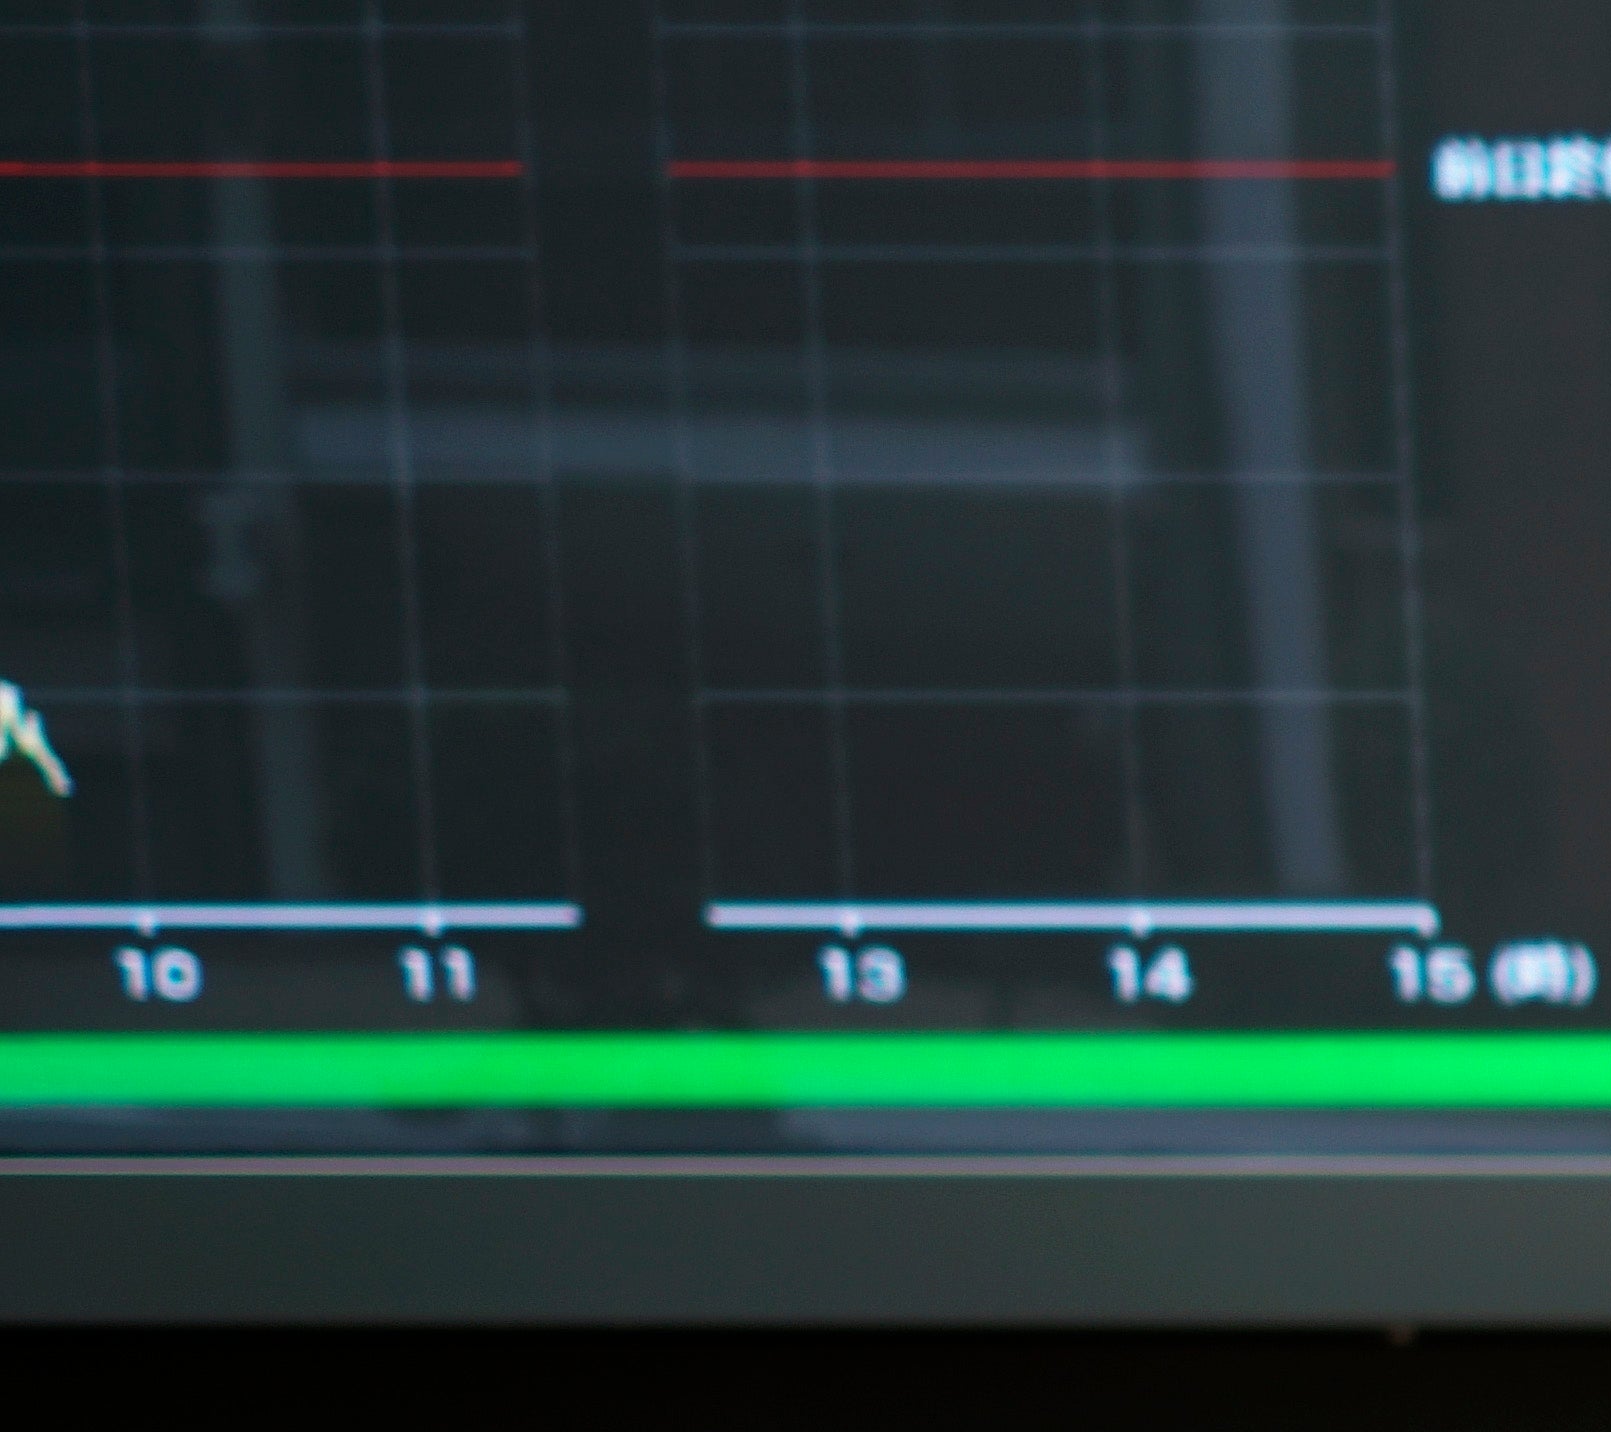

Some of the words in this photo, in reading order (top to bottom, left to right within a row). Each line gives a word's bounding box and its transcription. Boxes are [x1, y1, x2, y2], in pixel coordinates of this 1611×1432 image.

[118, 948, 200, 1000] 10
[403, 948, 473, 1000] 11
[822, 948, 903, 1002] 13
[1110, 948, 1191, 1002] 14
[1390, 947, 1475, 1002] 15
